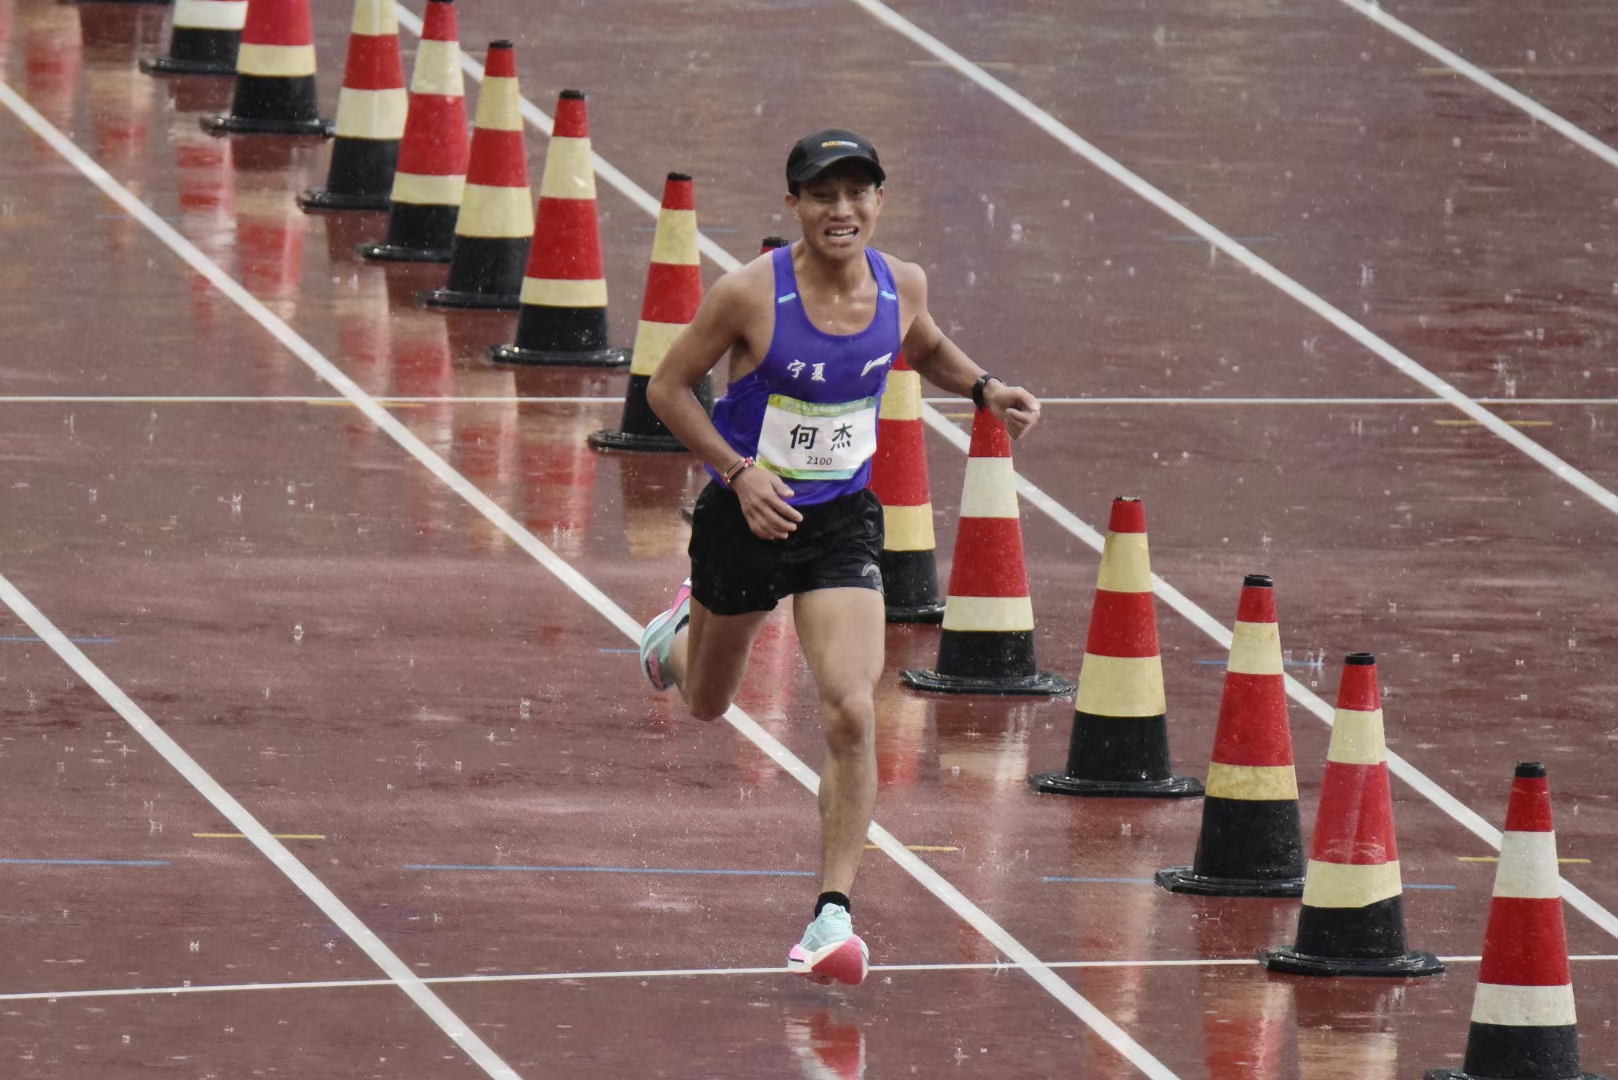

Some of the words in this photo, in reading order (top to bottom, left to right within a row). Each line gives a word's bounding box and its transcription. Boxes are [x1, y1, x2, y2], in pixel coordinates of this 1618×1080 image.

[787, 359, 826, 383] 宁夏
[790, 423, 853, 451] 何杰
[806, 456, 833, 466] 2100
